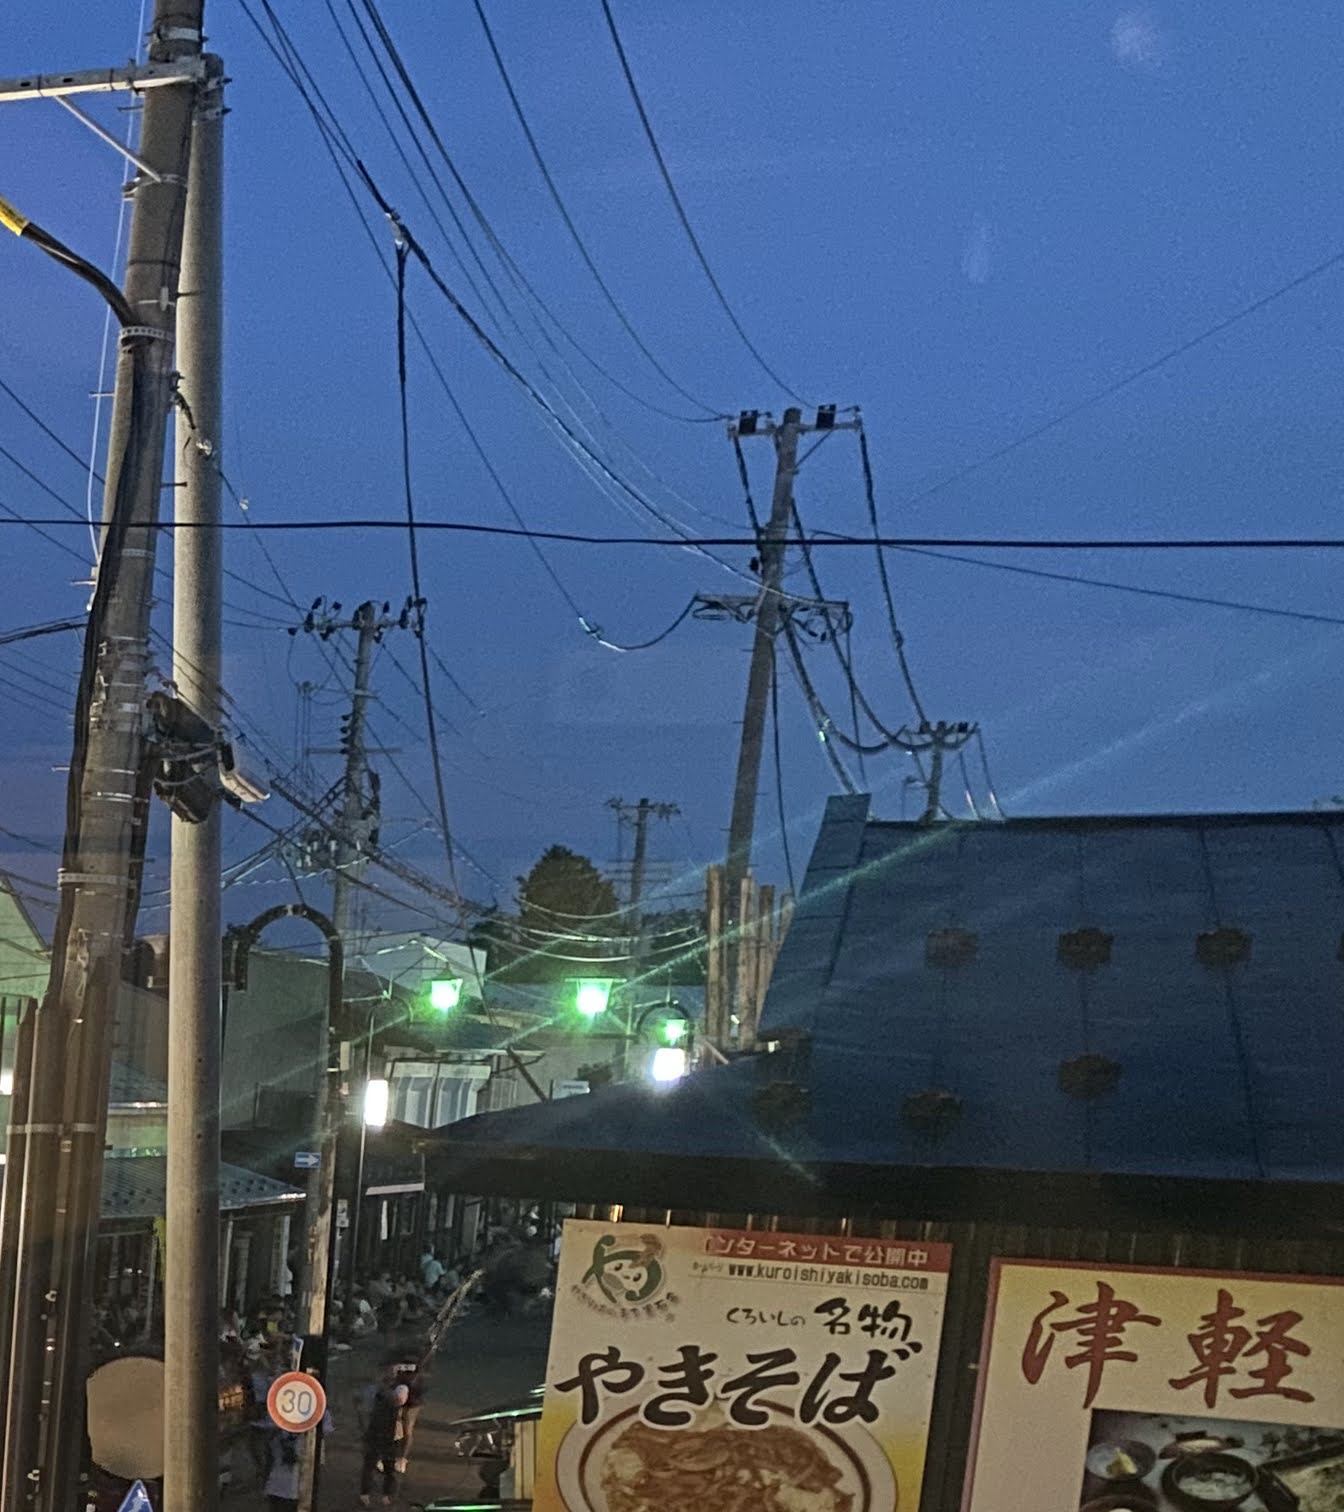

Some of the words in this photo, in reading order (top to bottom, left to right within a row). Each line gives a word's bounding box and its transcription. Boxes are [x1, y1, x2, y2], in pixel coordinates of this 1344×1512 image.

[728, 1262, 929, 1290] www.kuroishiyakisoba.com
[726, 1306, 806, 1326] くろいしの
[814, 1298, 913, 1342] 名物
[1021, 1281, 1315, 1410] 津軽
[281, 1389, 312, 1416] 30
[554, 1344, 923, 1426] やきそば
